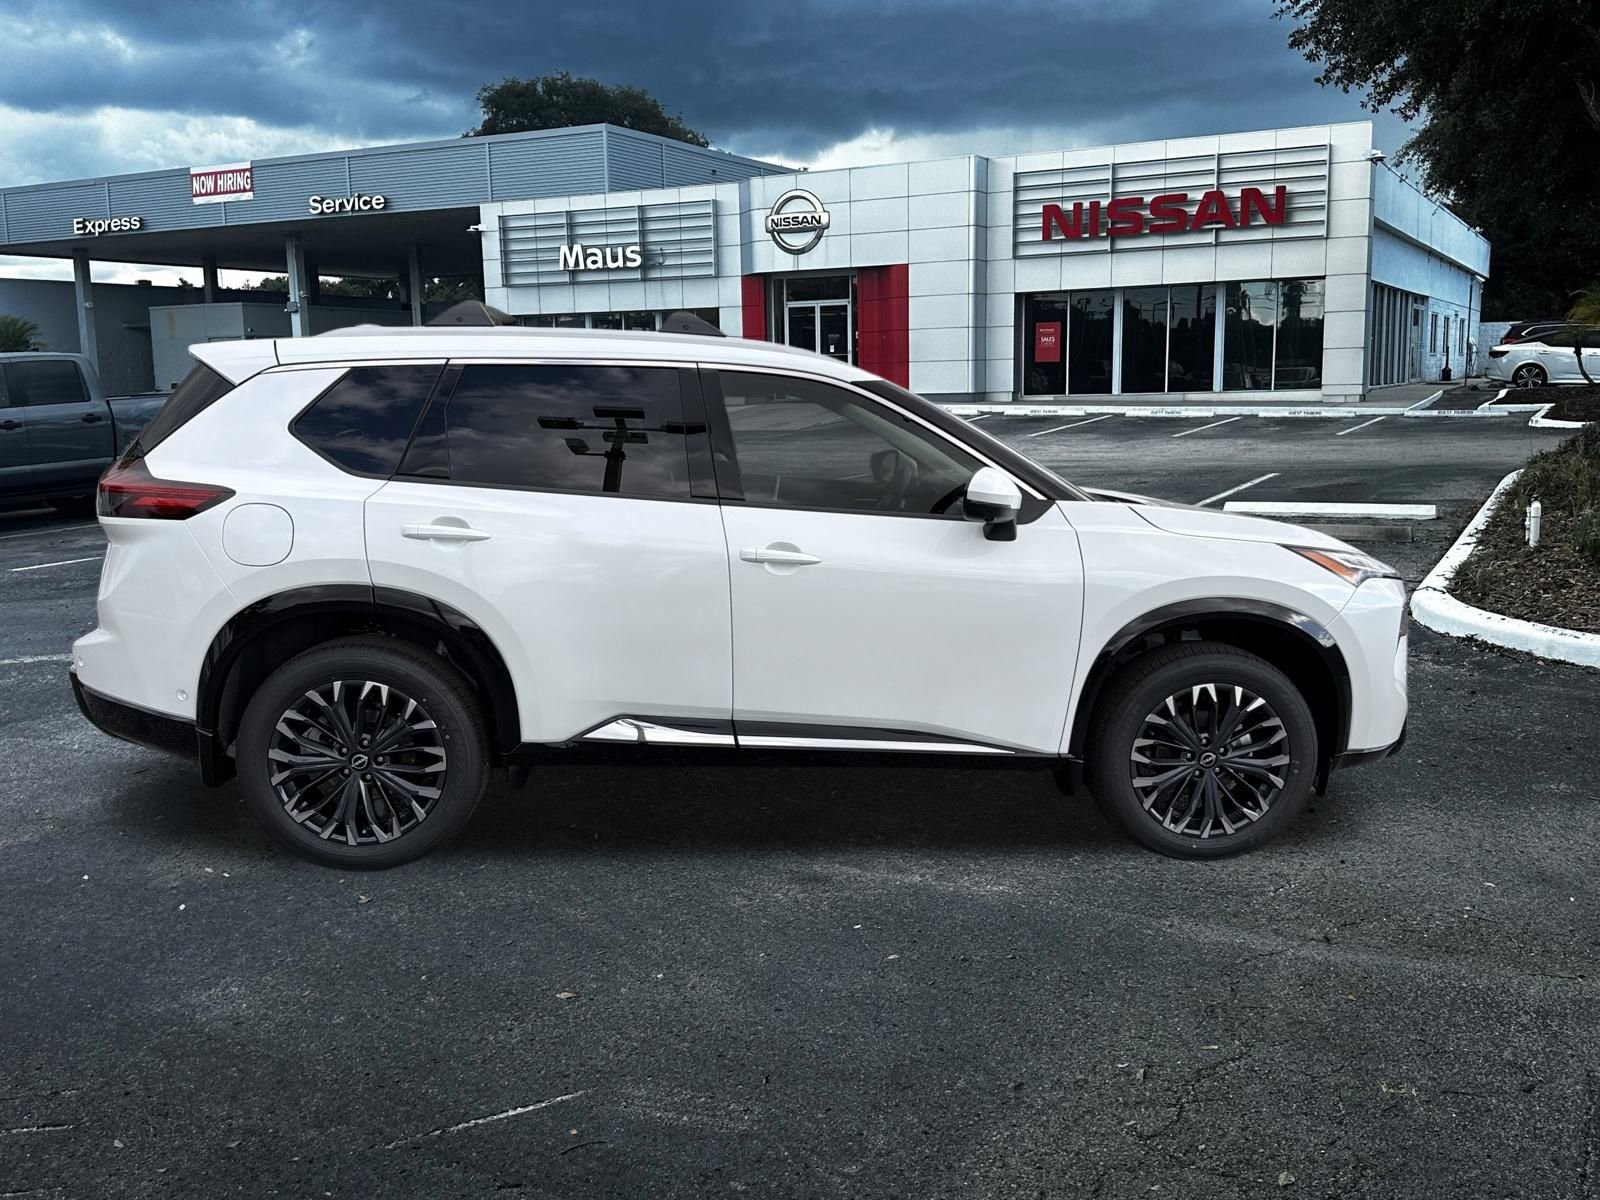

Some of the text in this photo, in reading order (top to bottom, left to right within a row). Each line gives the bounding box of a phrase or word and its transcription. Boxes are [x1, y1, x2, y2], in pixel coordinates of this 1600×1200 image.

[192, 171, 251, 195] NOW HIRING
[308, 192, 386, 215] Service
[1041, 185, 1287, 241] NISSAN
[73, 215, 141, 236] Express
[770, 214, 822, 229] NISSAN
[559, 243, 642, 271] Maus
